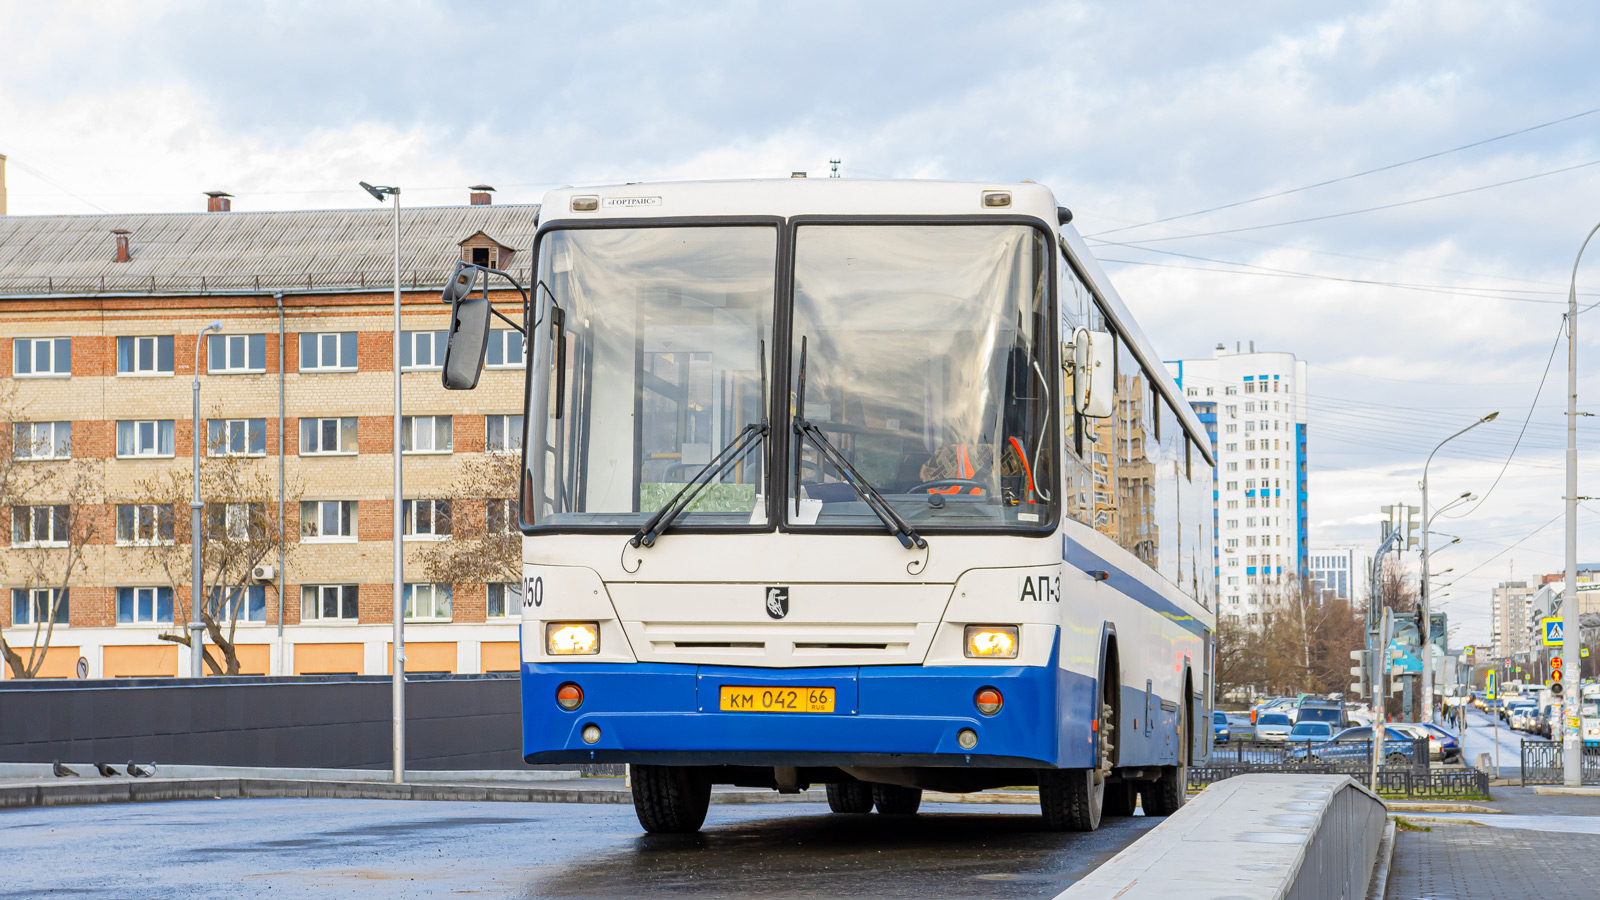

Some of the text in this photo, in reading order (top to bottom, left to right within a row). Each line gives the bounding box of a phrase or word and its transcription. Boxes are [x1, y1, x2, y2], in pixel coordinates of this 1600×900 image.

[730, 690, 828, 709] КМ 042 66
